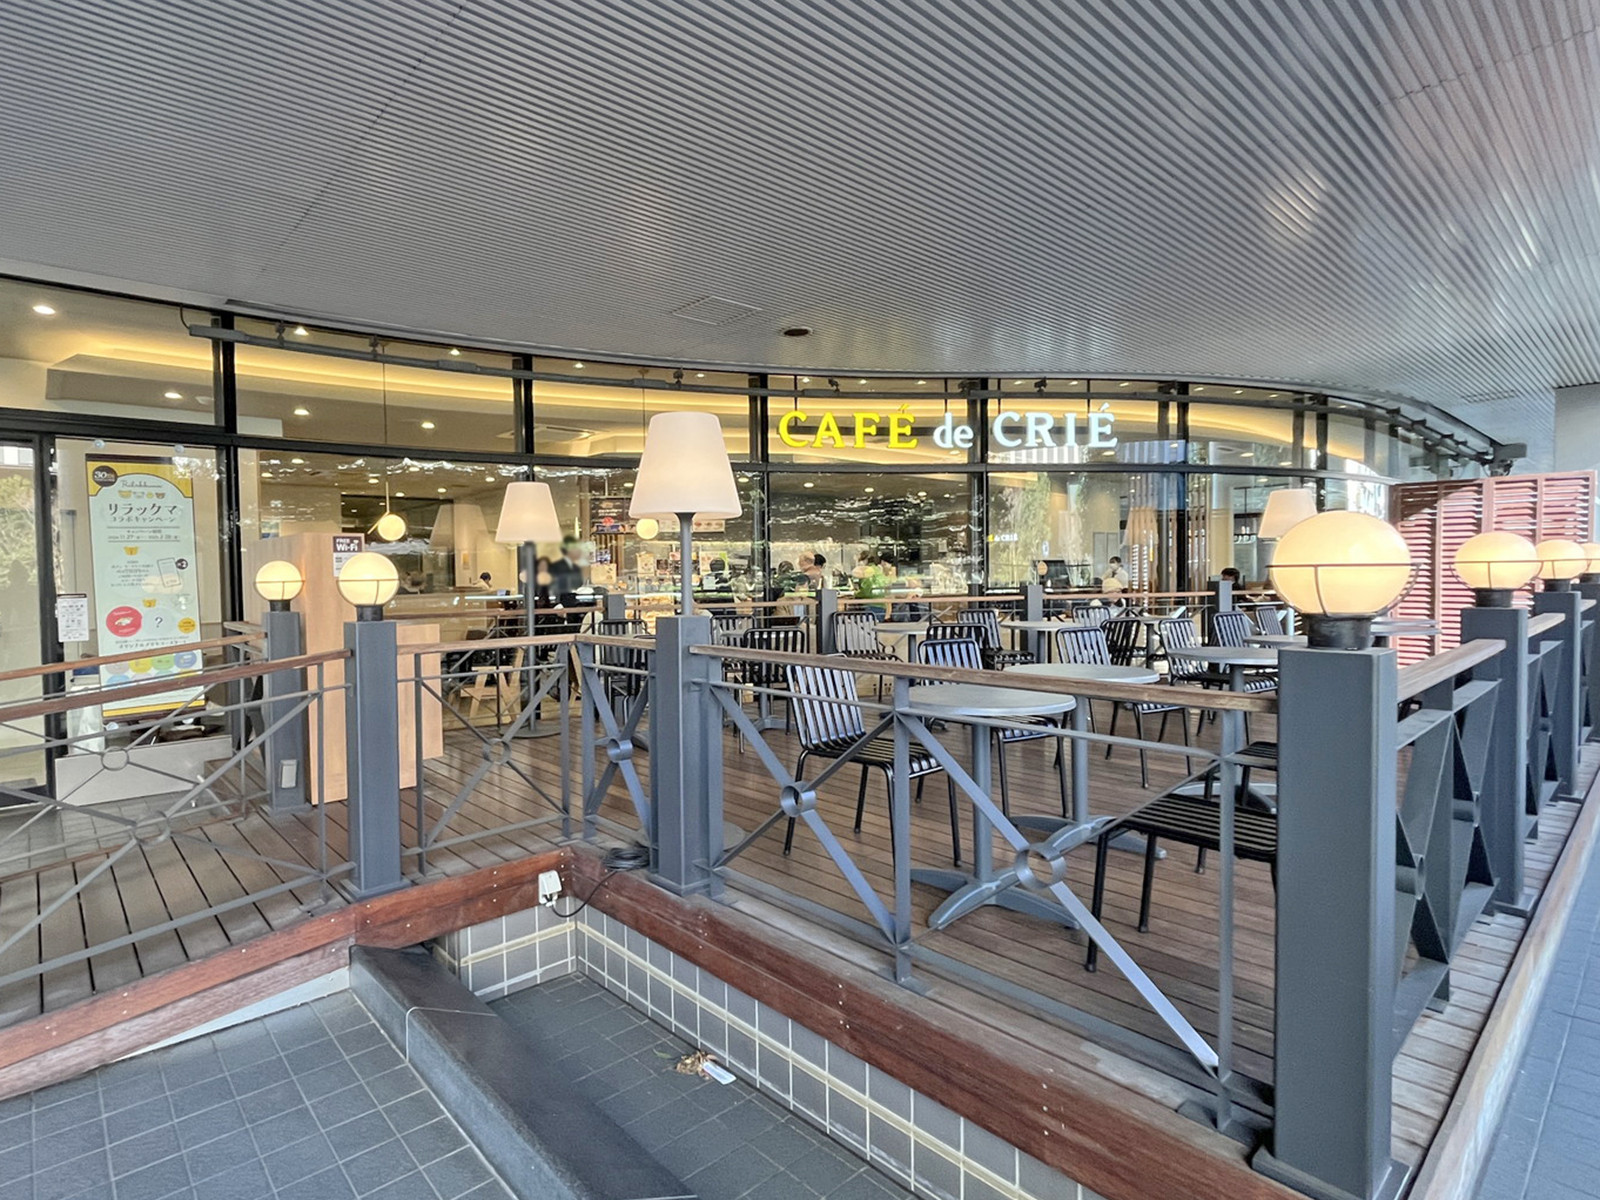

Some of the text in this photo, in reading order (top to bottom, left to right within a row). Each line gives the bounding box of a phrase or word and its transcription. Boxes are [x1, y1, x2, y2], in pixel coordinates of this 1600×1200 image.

[778, 403, 1118, 449] CAFÉ de CRIÉ
[109, 503, 177, 515] リラックマ
[336, 543, 358, 551] Wi-Fi
